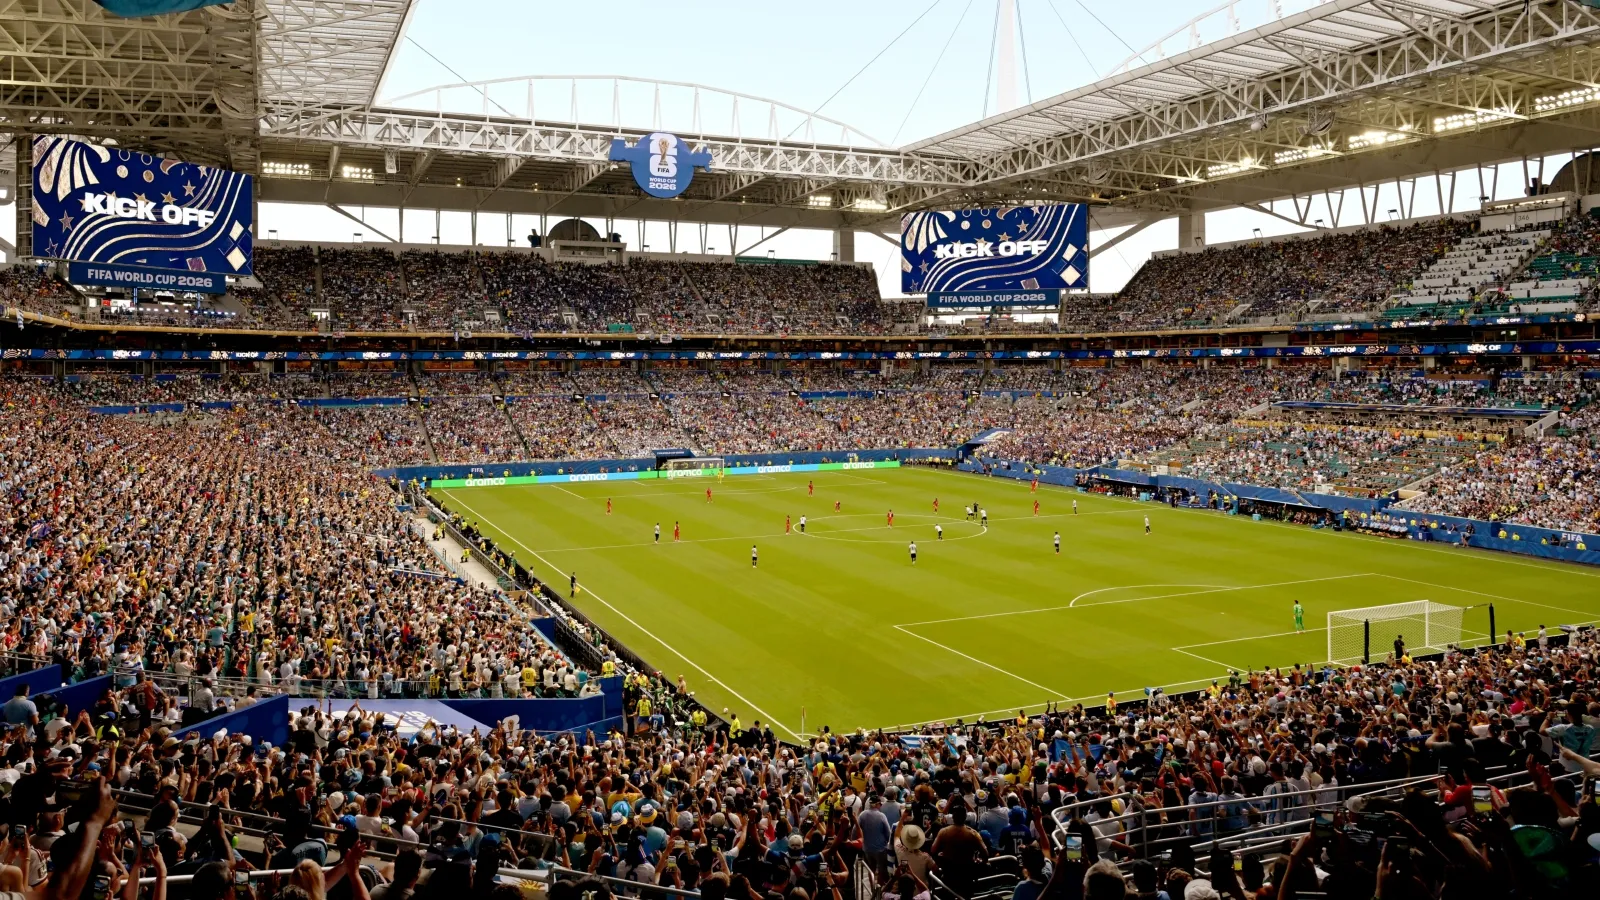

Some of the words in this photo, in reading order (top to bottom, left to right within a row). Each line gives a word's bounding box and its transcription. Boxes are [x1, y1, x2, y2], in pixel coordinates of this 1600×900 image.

[84, 192, 157, 222] KICK
[162, 205, 215, 228] OFF
[936, 243, 995, 259] KICK
[998, 240, 1049, 257] OFF
[87, 268, 113, 281] FIFA
[114, 270, 154, 284] WORLD
[155, 274, 177, 286] CUP
[177, 276, 213, 288] 2026
[939, 295, 959, 303] FIFA
[959, 295, 993, 303] WORLD
[993, 294, 1013, 302] CUP
[1013, 293, 1046, 302] 2026
[757, 464, 791, 474] aramco
[842, 461, 875, 470] aramco
[465, 477, 506, 487] aramco
[569, 473, 608, 482] aramco
[1562, 532, 1583, 541] FIFA
